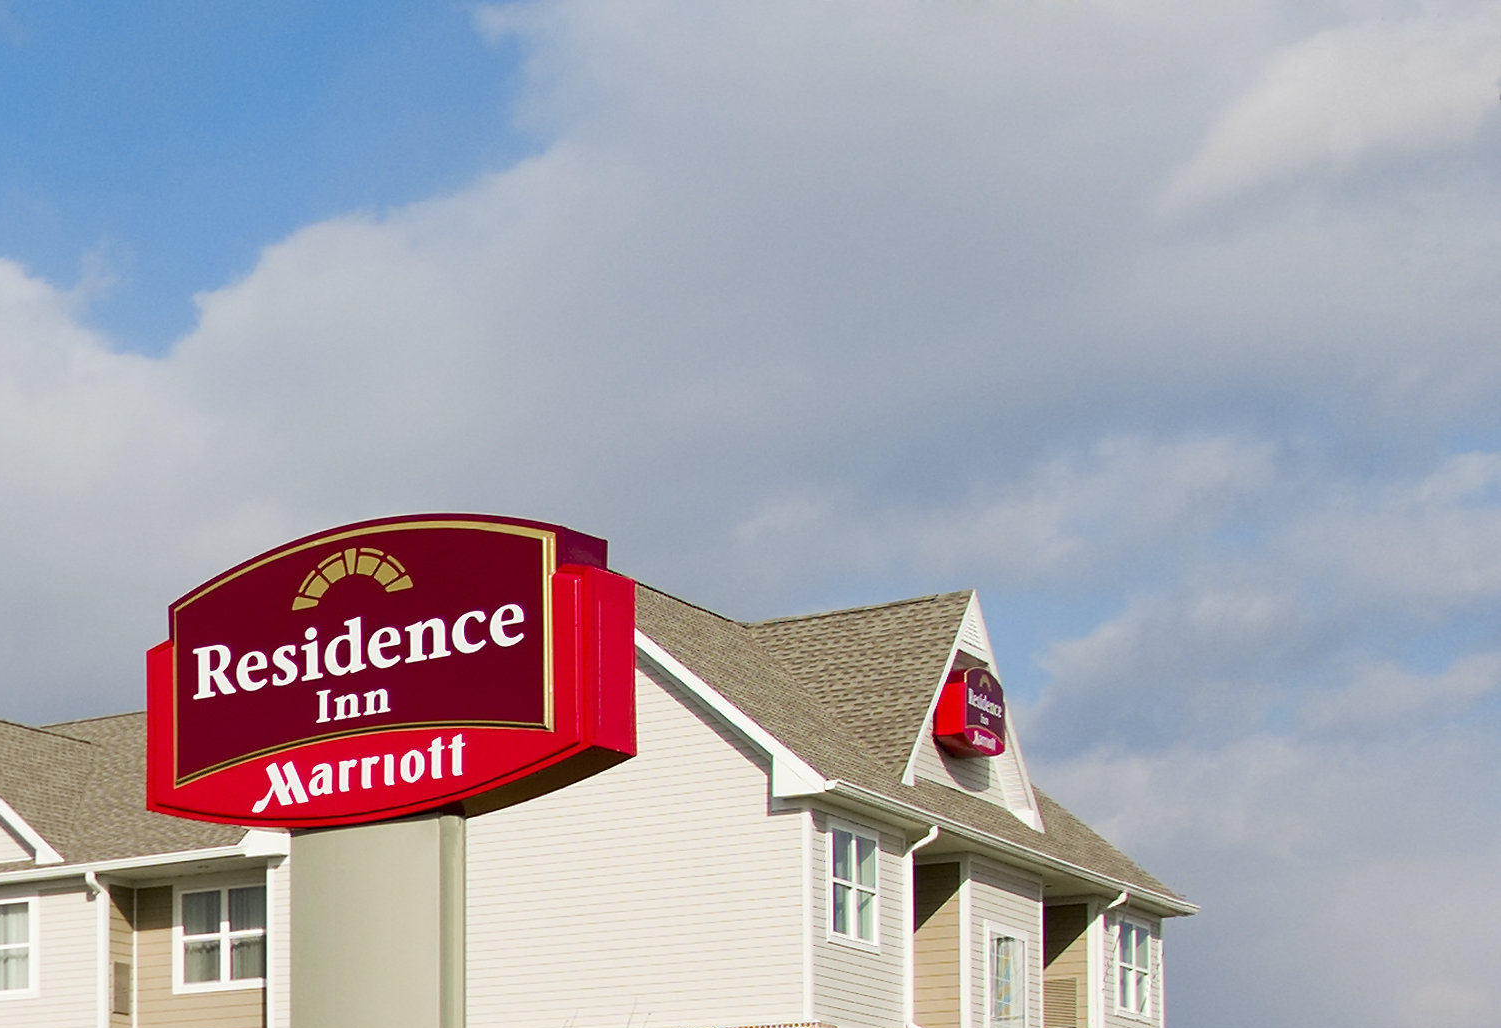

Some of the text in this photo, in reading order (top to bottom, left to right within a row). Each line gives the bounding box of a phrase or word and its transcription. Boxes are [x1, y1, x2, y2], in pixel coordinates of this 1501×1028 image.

[192, 603, 525, 700] Residence
[315, 688, 391, 724] Inn
[251, 734, 466, 813] Marriott
